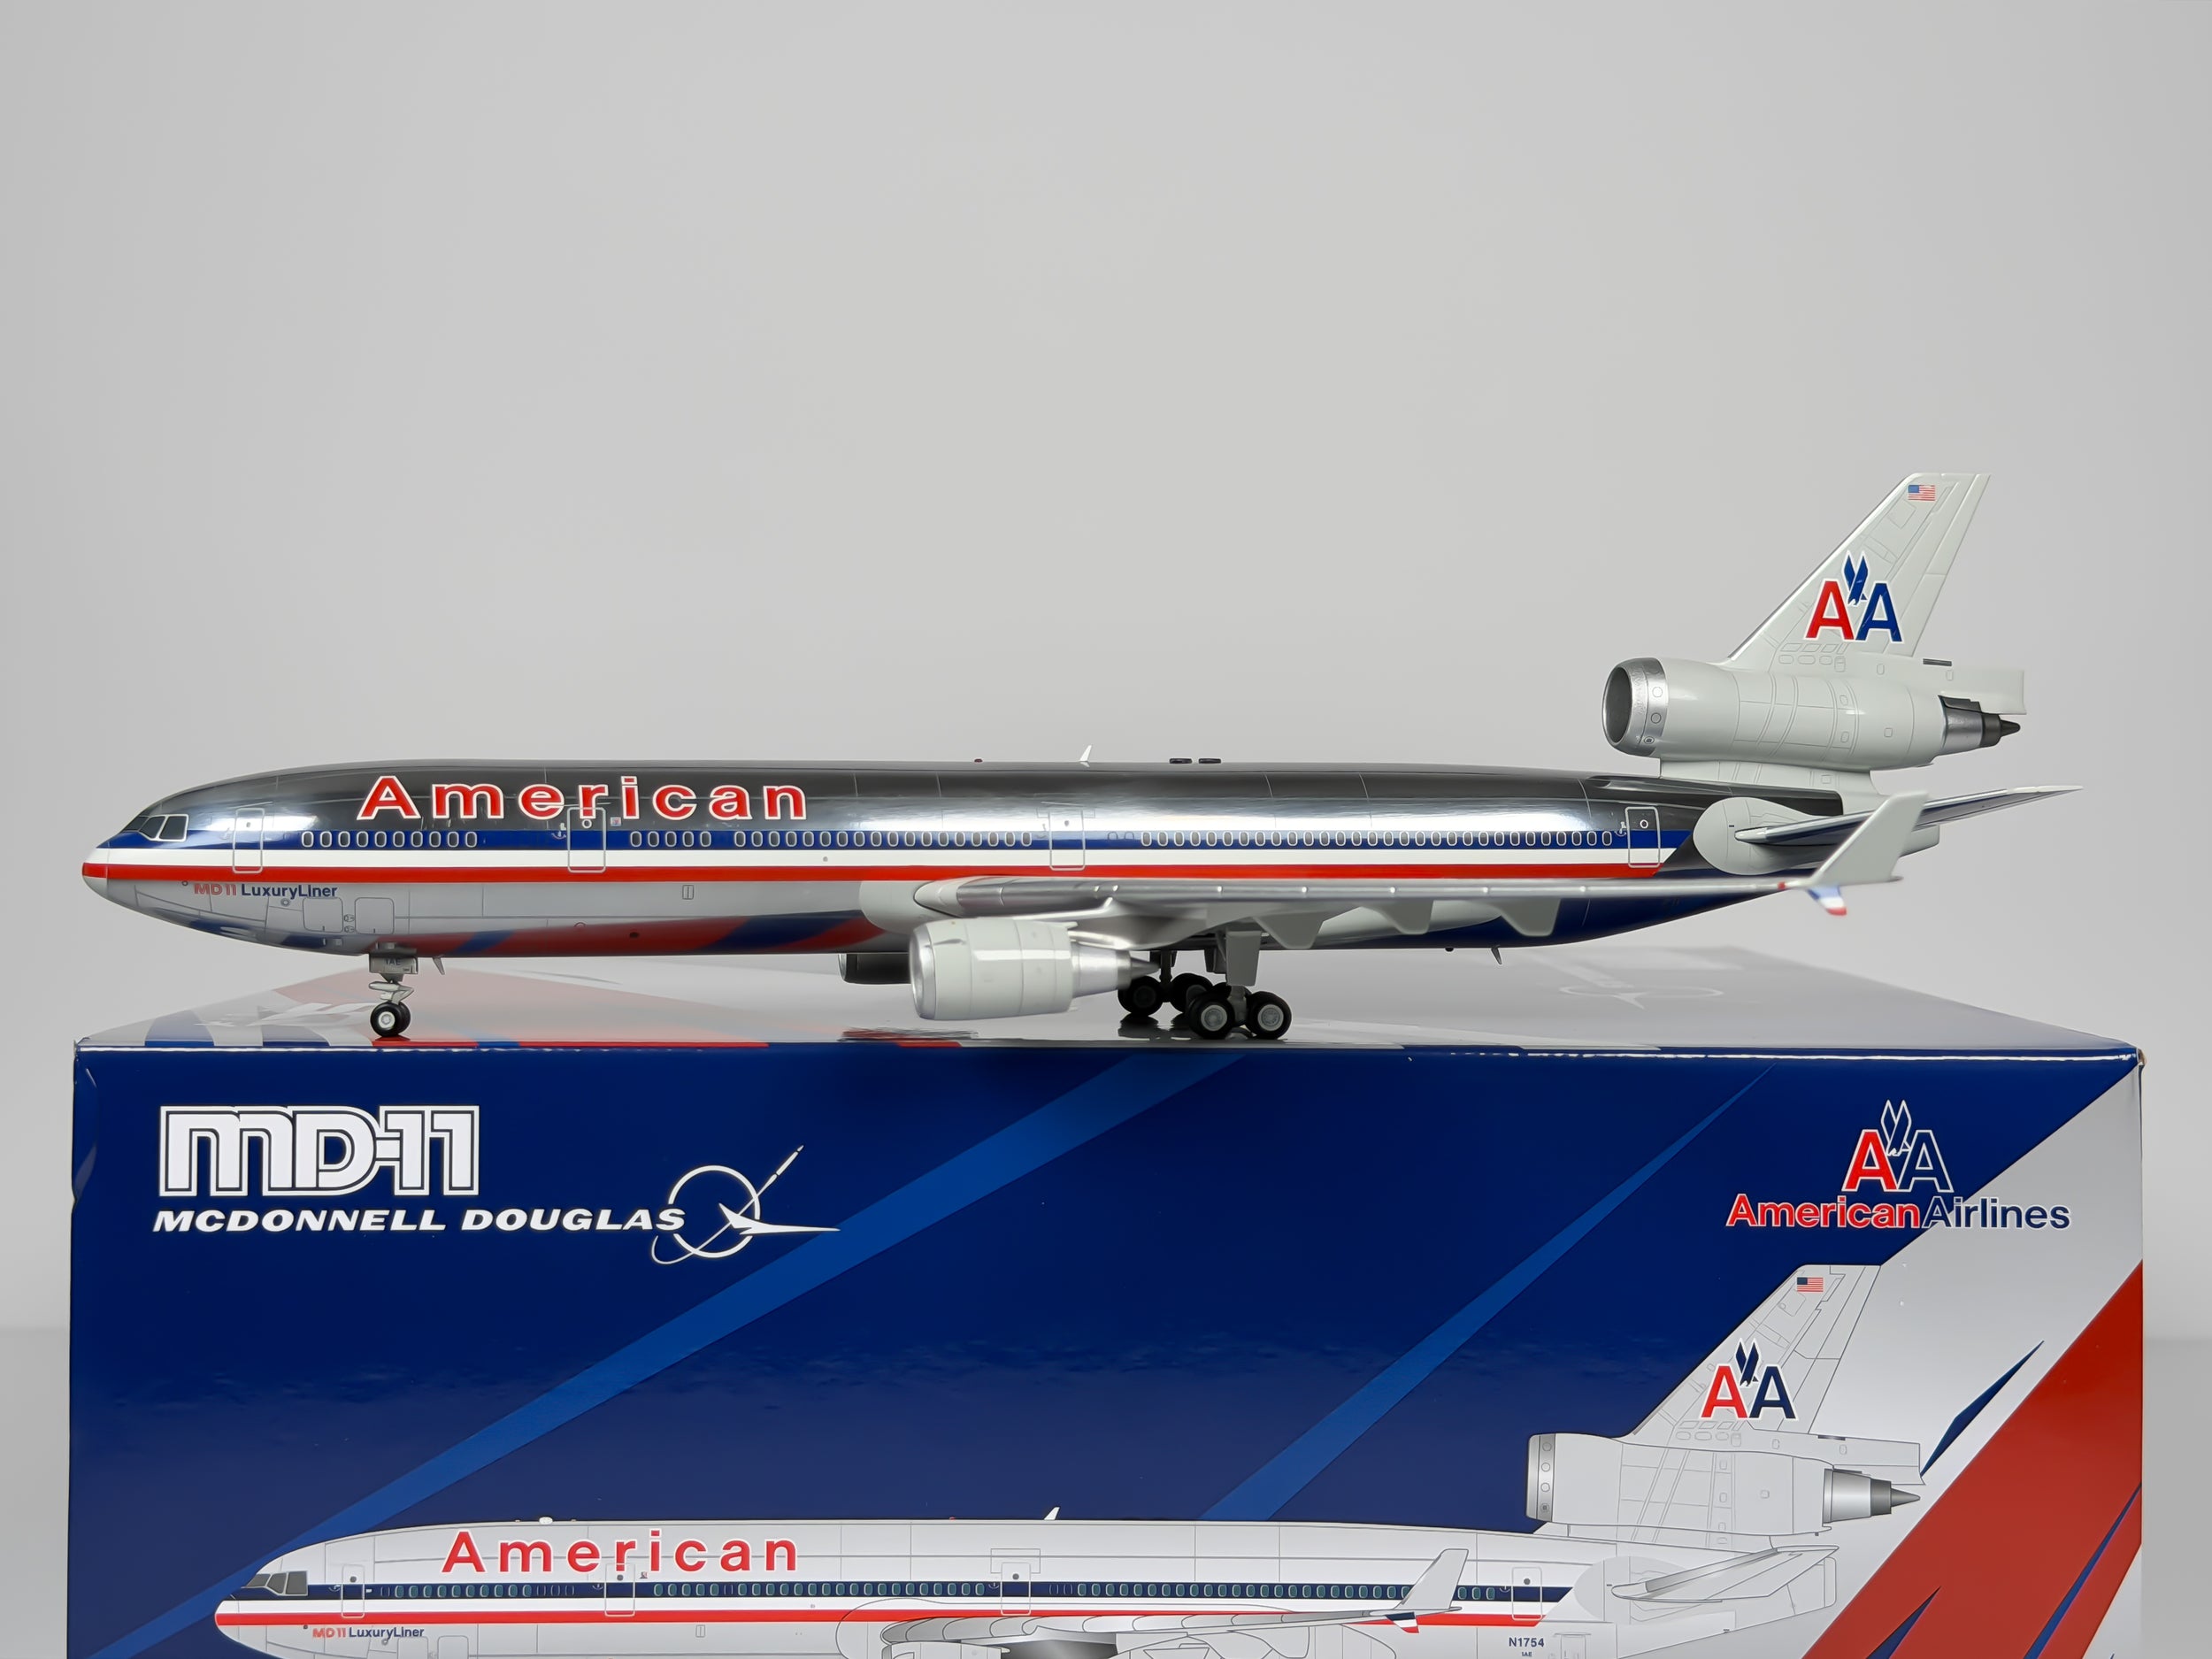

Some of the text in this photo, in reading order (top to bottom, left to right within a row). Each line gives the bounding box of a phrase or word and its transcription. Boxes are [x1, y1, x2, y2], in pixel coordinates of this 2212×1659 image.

[1804, 579, 1903, 643] AA
[357, 775, 807, 821] American
[242, 883, 337, 899] LuxuryLiner
[159, 1106, 479, 1196] MD-11
[1841, 1129, 1954, 1193] AA
[152, 1209, 686, 1232] MCDONNELL DOUGLAS
[1700, 1364, 1798, 1420] AA
[440, 1529, 798, 1572] American
[349, 1626, 425, 1640] LuxuryLiner
[1509, 1637, 1545, 1647] N1754
